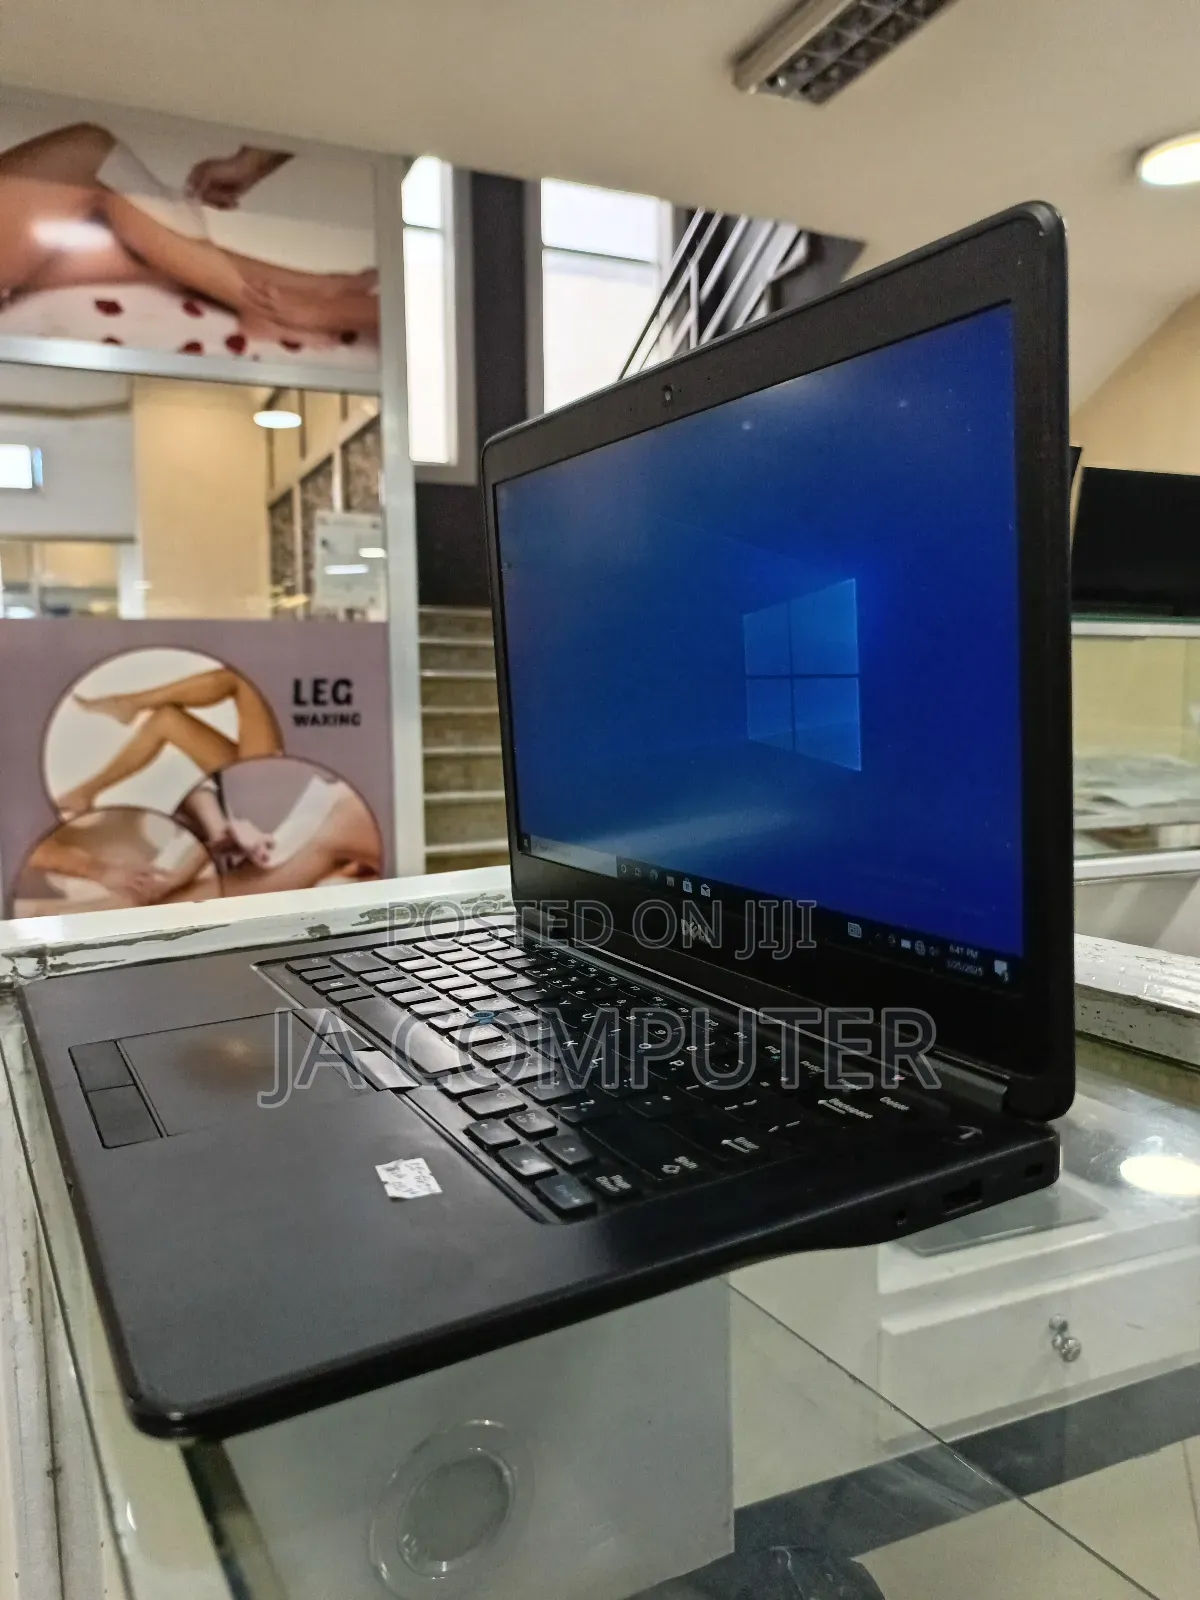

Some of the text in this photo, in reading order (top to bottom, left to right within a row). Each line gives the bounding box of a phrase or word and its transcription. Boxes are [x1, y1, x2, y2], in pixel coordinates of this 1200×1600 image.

[293, 677, 353, 707] LEG
[293, 711, 362, 728] WAXING
[680, 918, 712, 944] DELL
